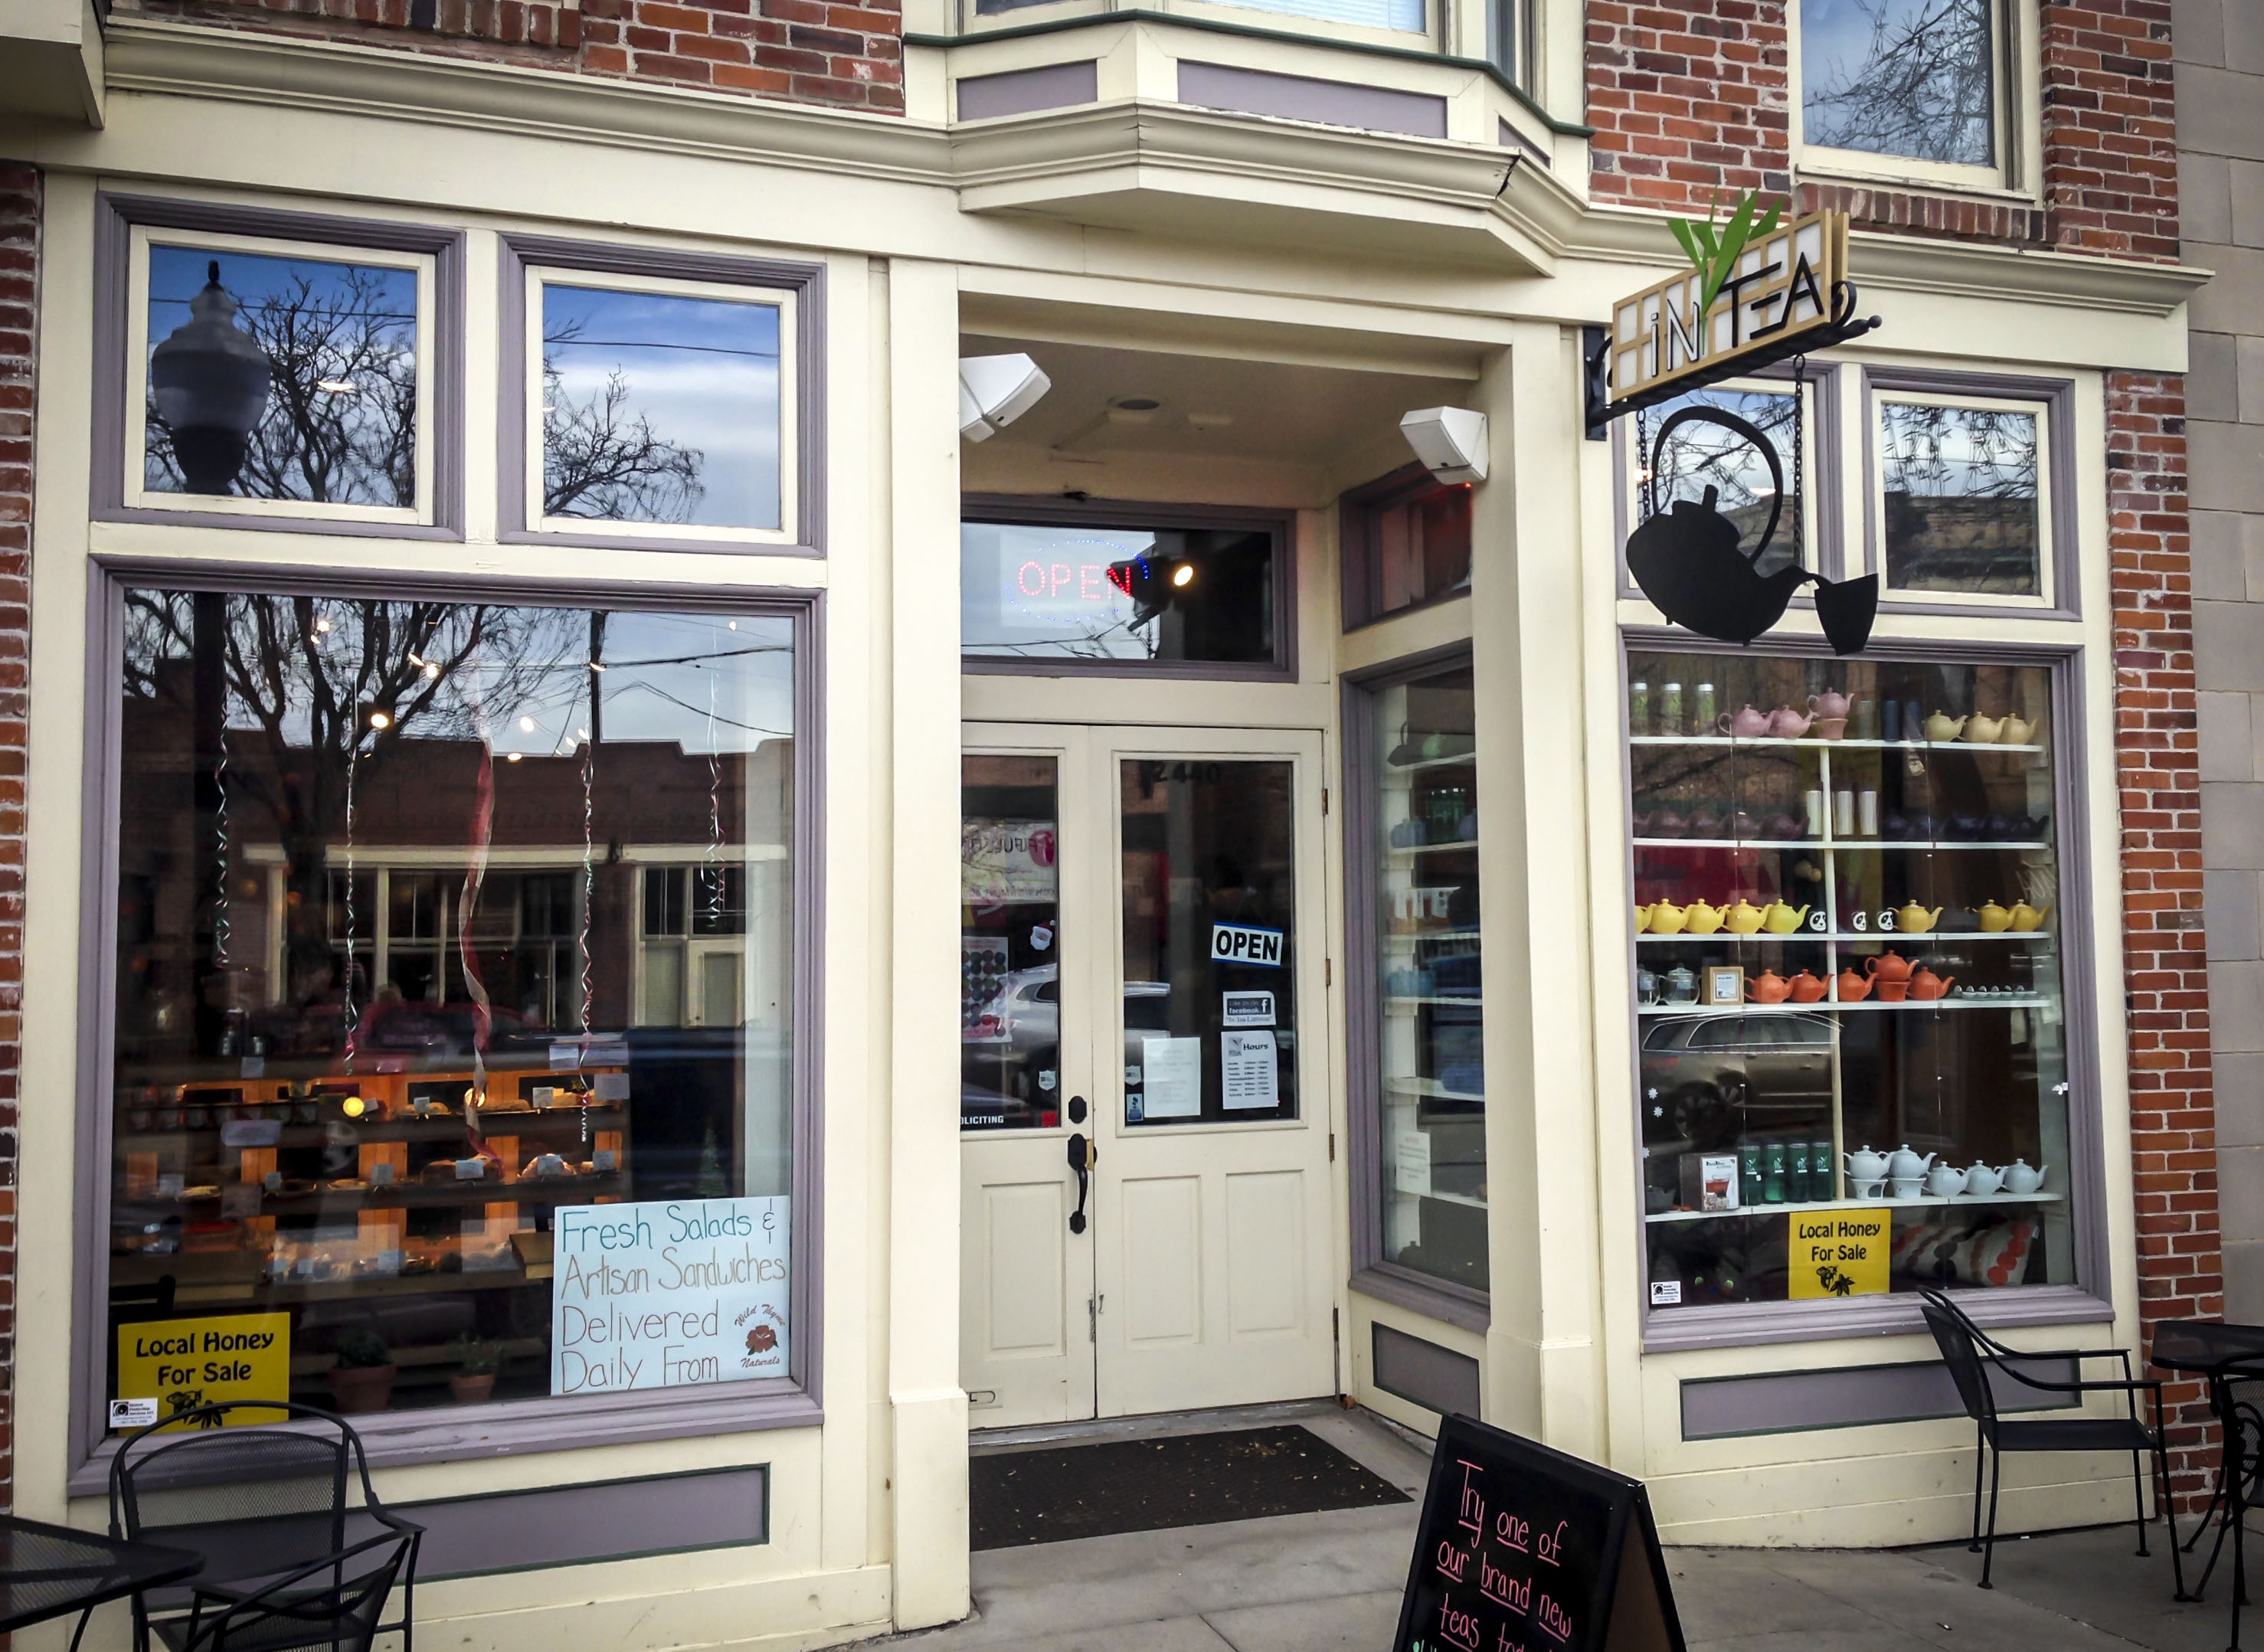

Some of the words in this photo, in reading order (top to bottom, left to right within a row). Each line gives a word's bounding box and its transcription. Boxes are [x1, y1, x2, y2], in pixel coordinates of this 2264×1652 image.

[1018, 561, 1131, 599] OPEN
[1216, 930, 1278, 960] OPEN
[563, 1207, 653, 1252] Fresh
[666, 1202, 752, 1243] Salads
[1799, 1222, 1834, 1239] Local
[1838, 1222, 1881, 1237] Honey
[561, 1254, 649, 1300] Artisan
[658, 1241, 787, 1291] Sandwiches
[1811, 1245, 1834, 1261] For
[1838, 1244, 1866, 1260] Sale
[562, 1299, 719, 1346] Delivered
[734, 1304, 757, 1327] Wild
[136, 1333, 195, 1358] Local
[203, 1332, 274, 1353] Honey
[740, 1356, 780, 1368] Naturals
[158, 1366, 196, 1386] For
[203, 1360, 252, 1382] Sale
[561, 1346, 643, 1394] Daily
[663, 1344, 719, 1385] From
[1457, 1459, 1484, 1548] Try
[1497, 1511, 1530, 1546] one
[1538, 1520, 1568, 1559] of
[1438, 1541, 1470, 1575] our
[1480, 1552, 1532, 1610] brand
[1539, 1594, 1572, 1637] new
[1440, 1592, 1479, 1648] teas
